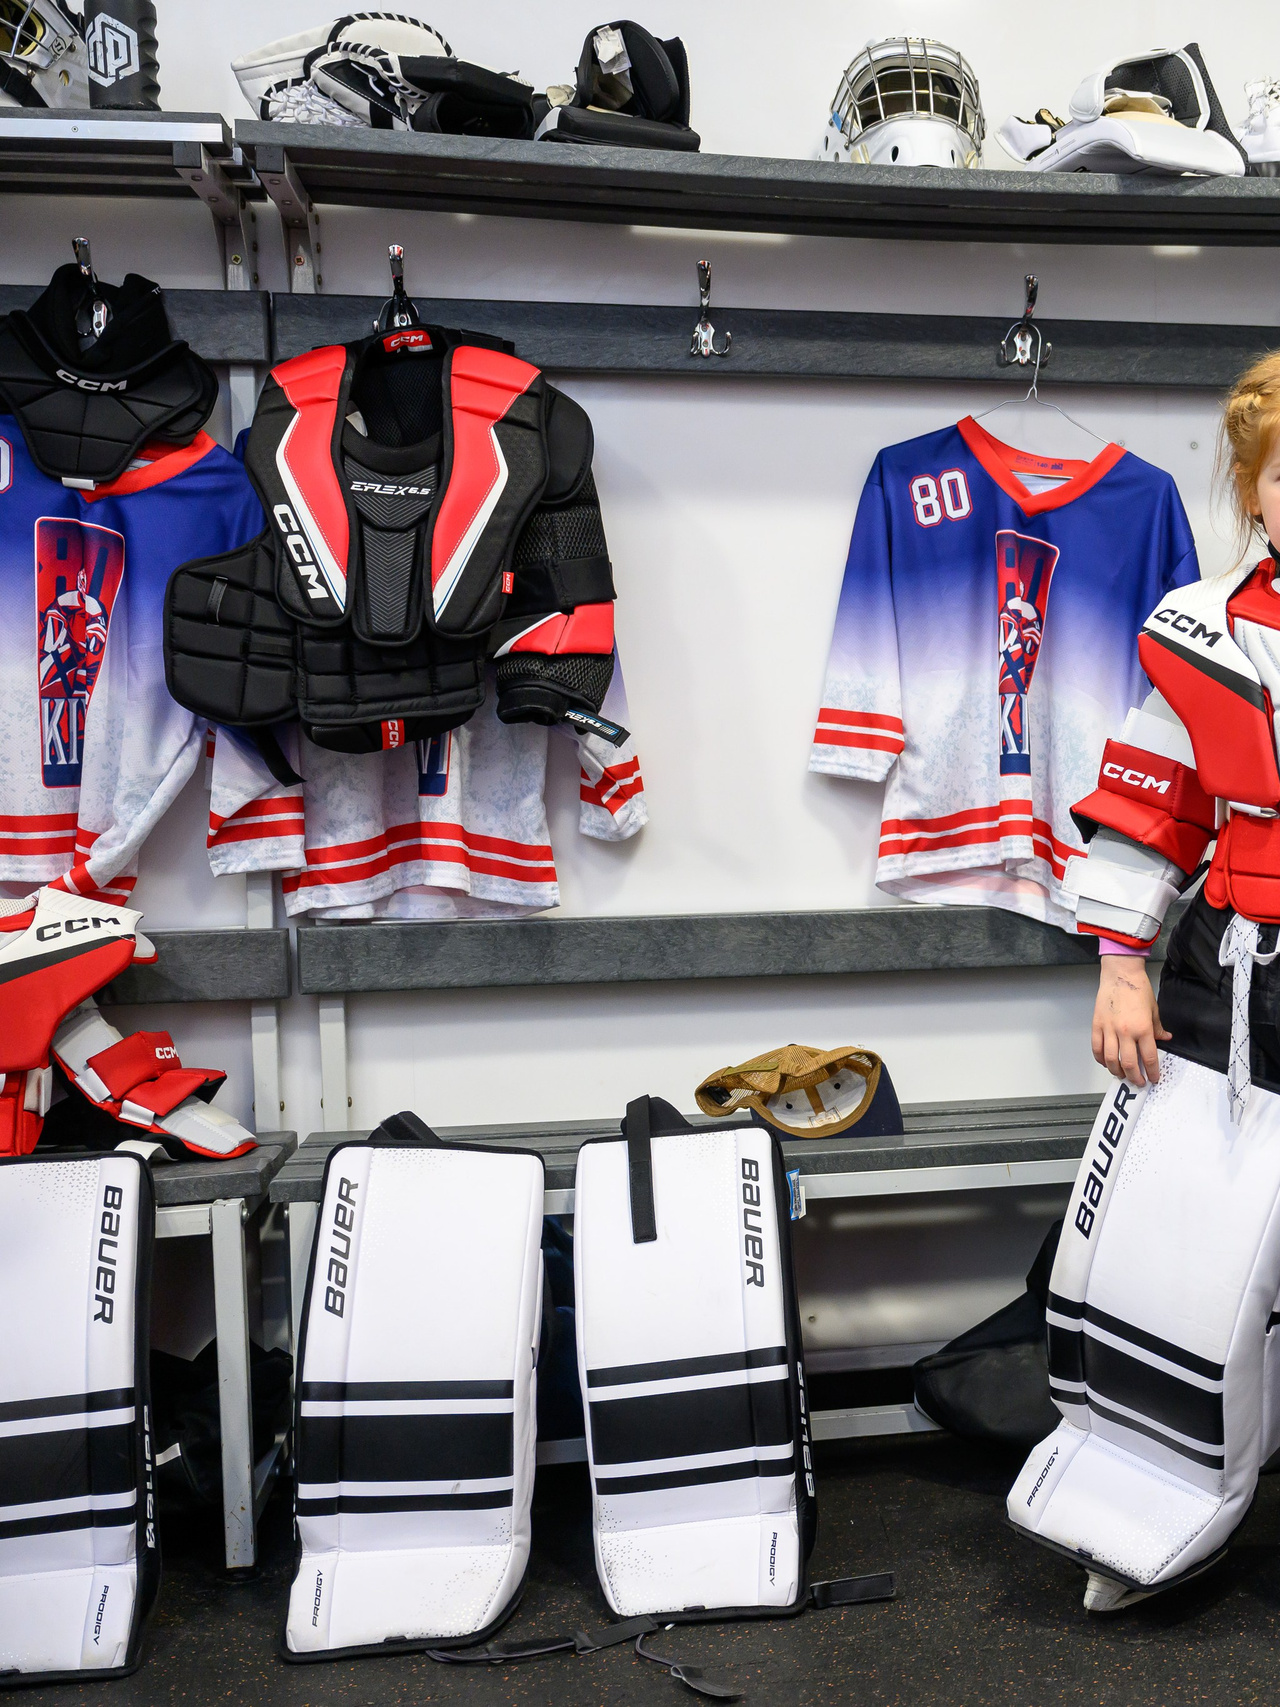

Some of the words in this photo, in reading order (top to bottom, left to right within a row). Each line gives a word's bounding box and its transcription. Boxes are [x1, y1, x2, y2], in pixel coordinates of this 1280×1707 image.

[391, 335, 424, 347] CCM
[56, 369, 127, 392] CCM
[909, 468, 973, 528] 80
[273, 504, 330, 599] CCM
[1154, 608, 1223, 648] CCM
[1102, 762, 1172, 796] CCM
[36, 917, 121, 942] CCM
[155, 1046, 179, 1060] CCM
[1027, 1446, 1060, 1507] PRODIGY
[770, 1531, 778, 1586] PRODIGY
[94, 1585, 110, 1646] PRODIGY
[312, 1569, 324, 1627] PRODIGY
